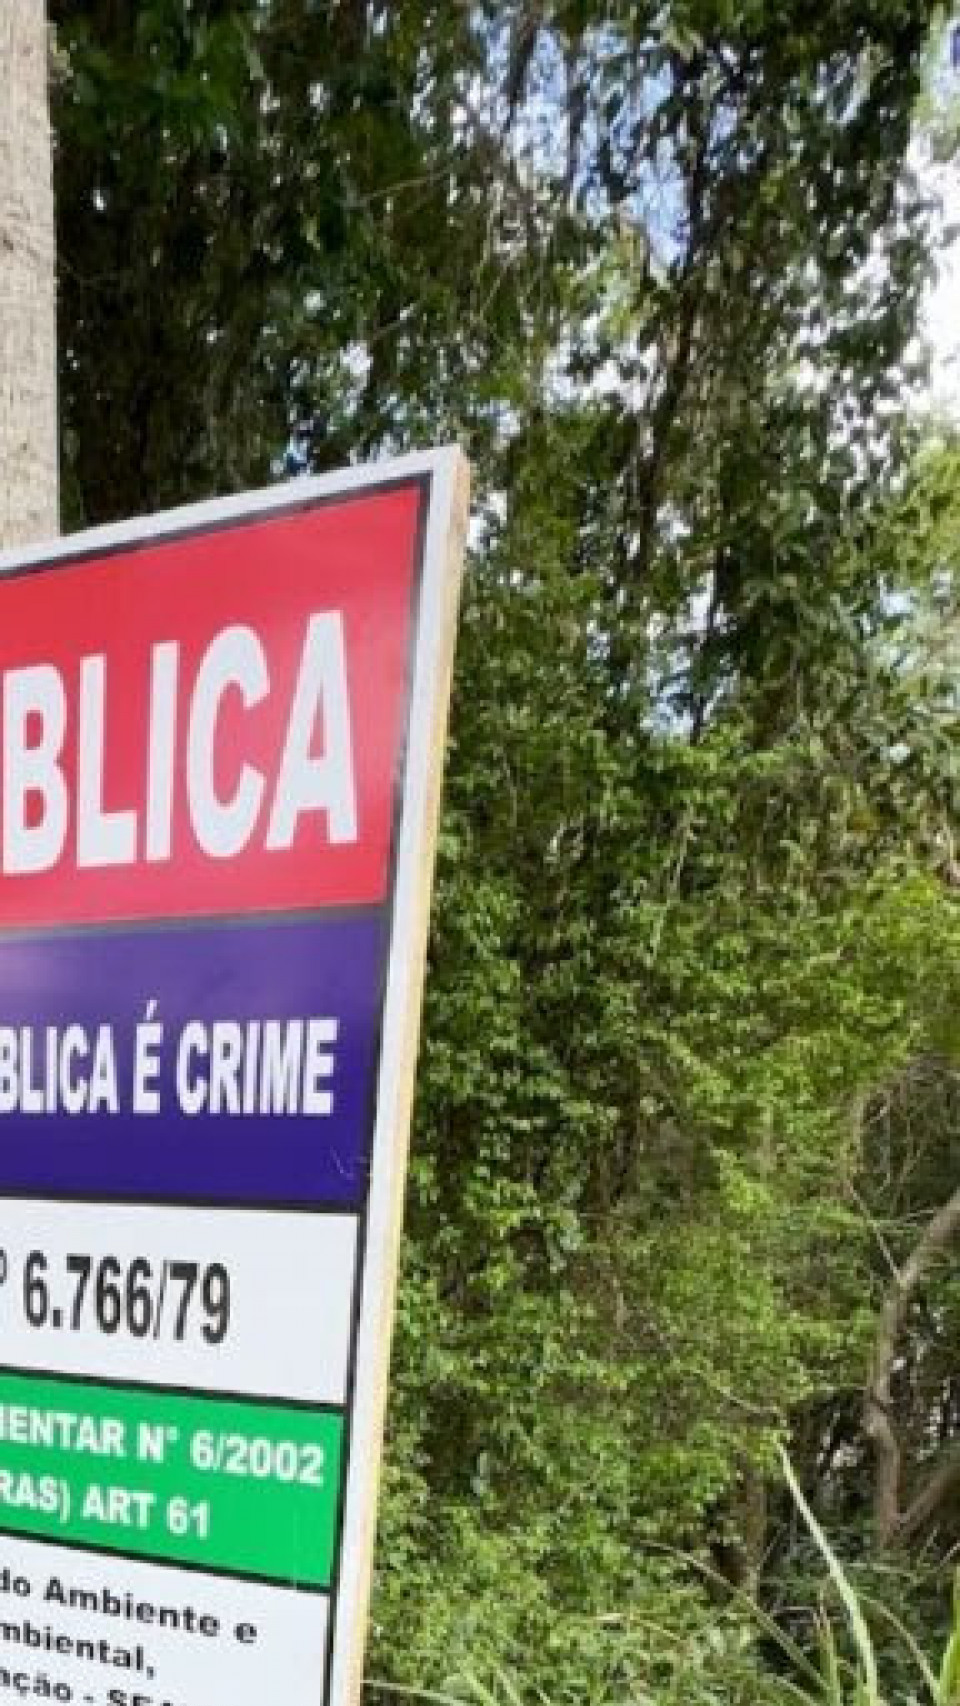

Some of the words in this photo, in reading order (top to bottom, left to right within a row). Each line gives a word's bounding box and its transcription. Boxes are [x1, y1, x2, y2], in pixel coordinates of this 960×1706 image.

[132, 999, 162, 1115] É
[177, 1016, 340, 1117] CRIME
[22, 1250, 231, 1344] 6.766/79
[192, 1430, 325, 1486] 6/2002
[82, 1484, 156, 1529] ART
[166, 1496, 209, 1539] 61
[44, 1575, 220, 1639] Ambiente
[235, 1619, 258, 1645] e
